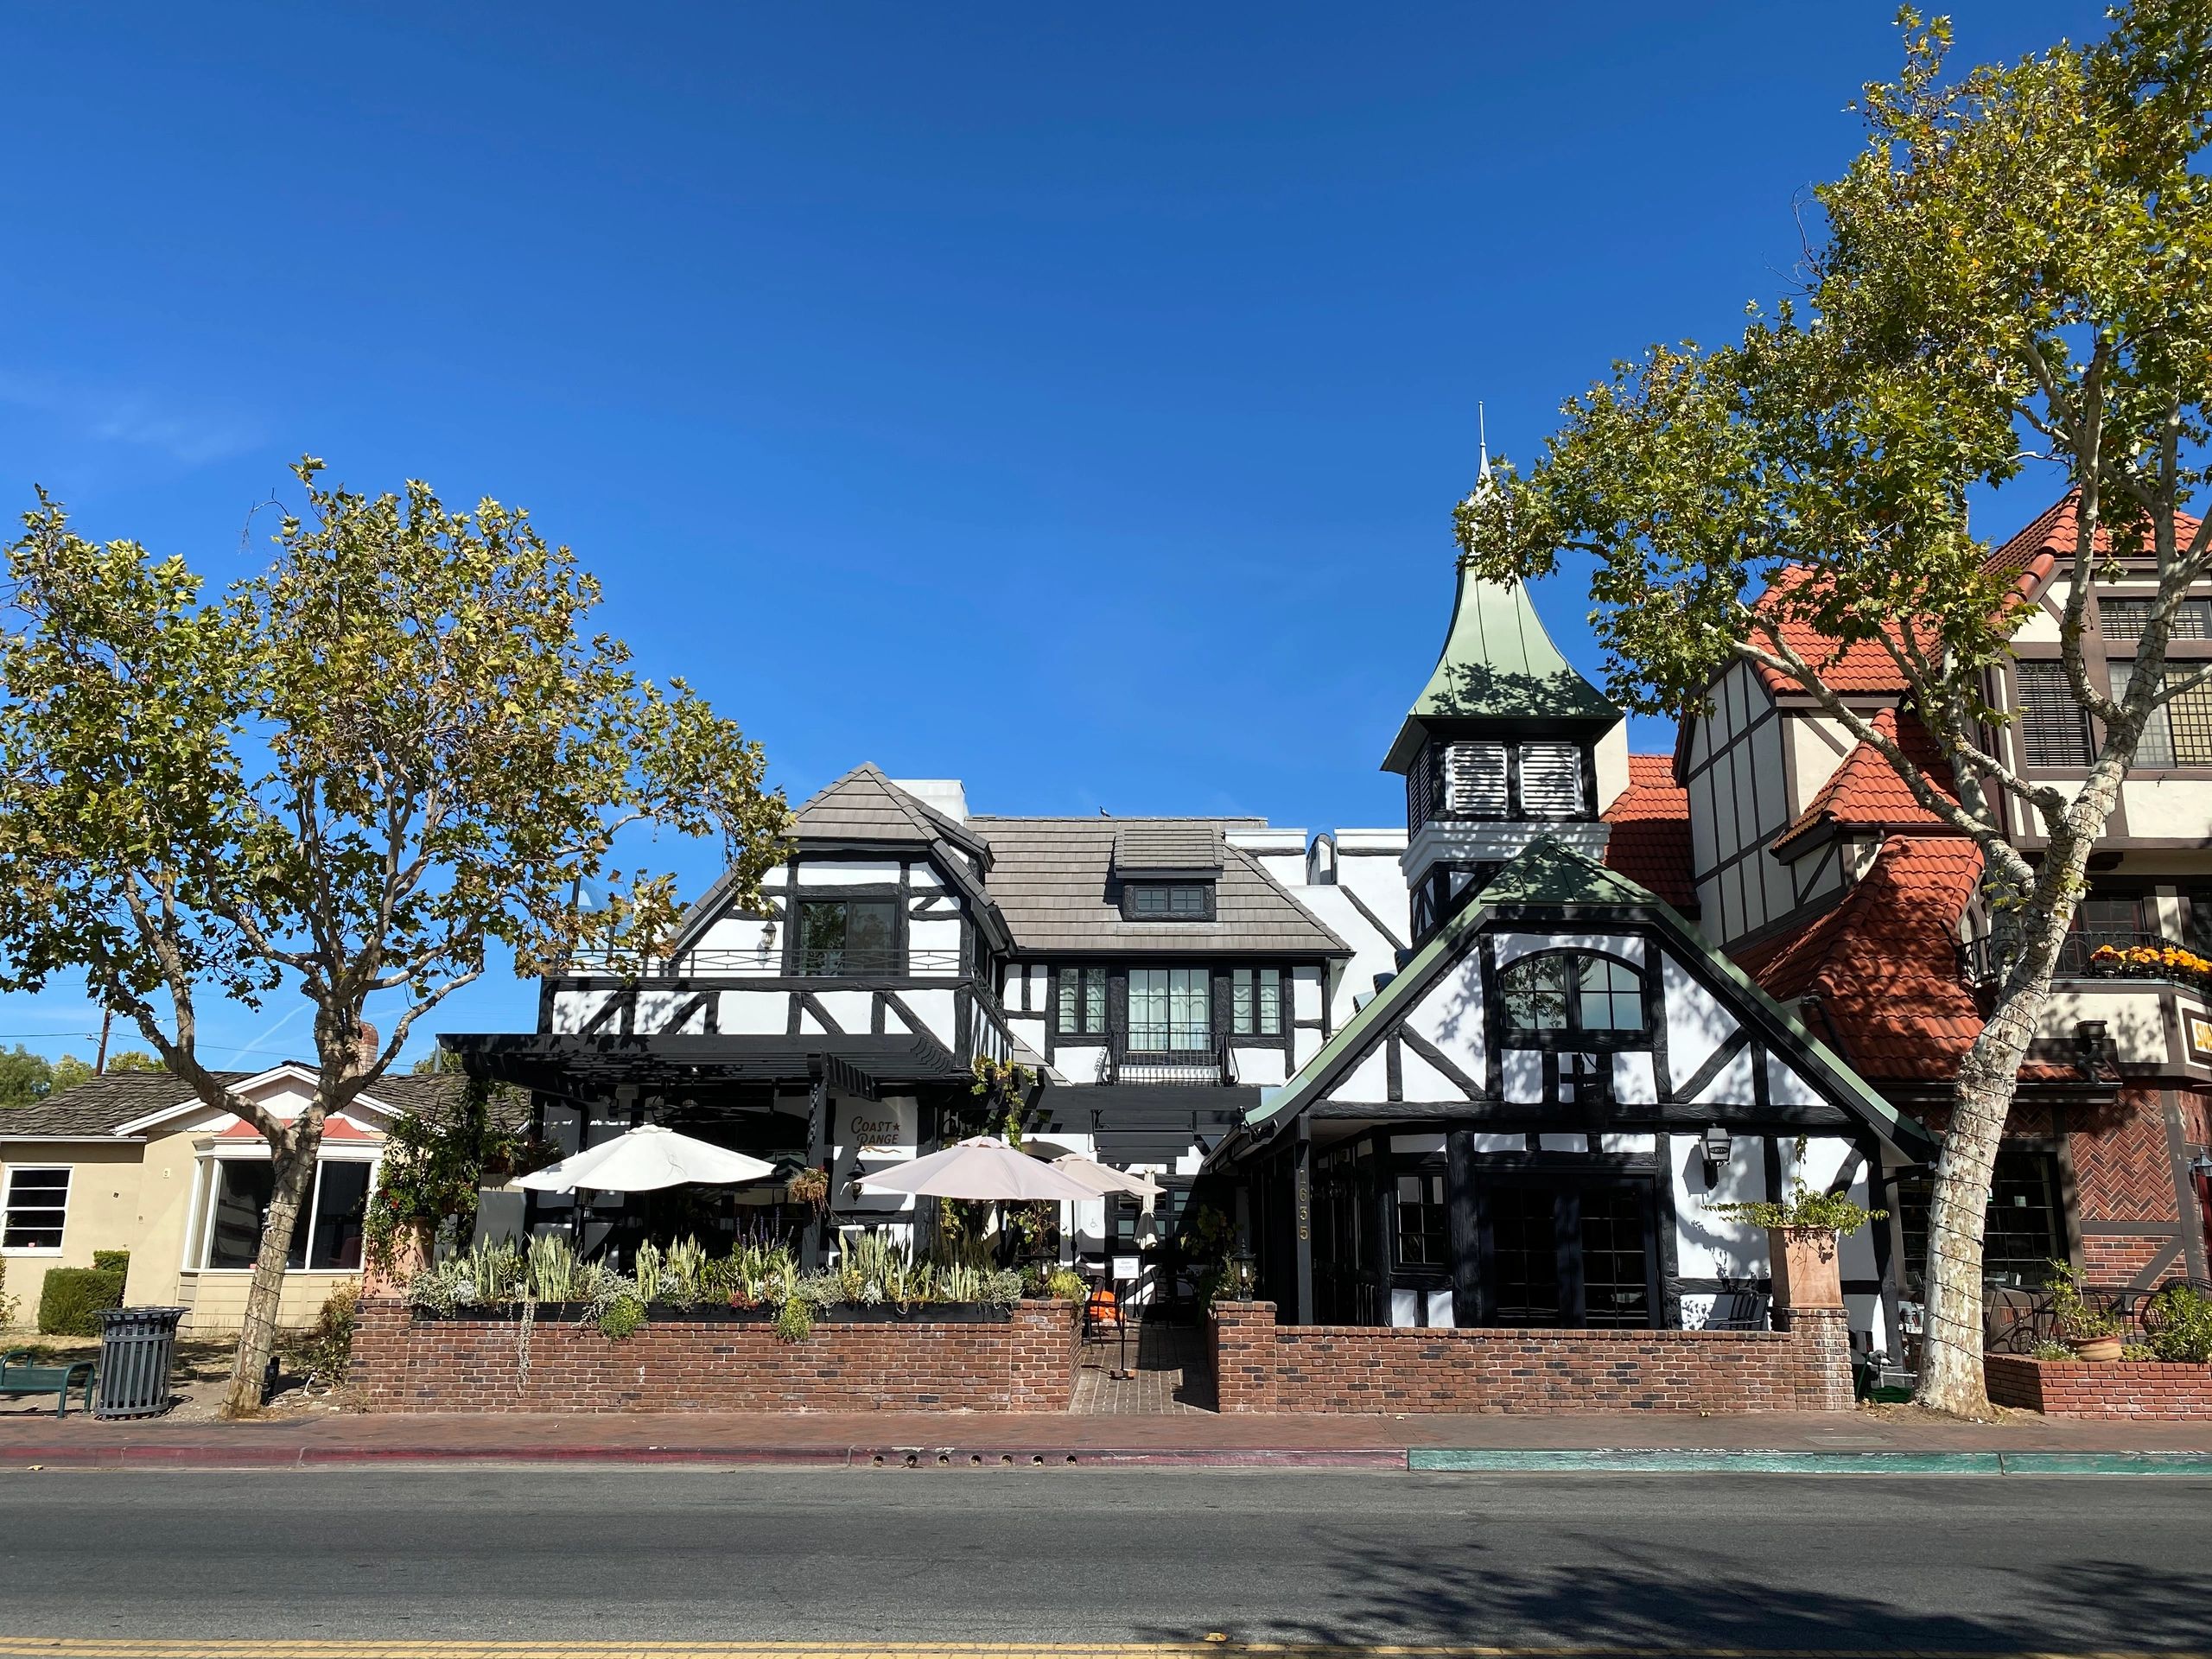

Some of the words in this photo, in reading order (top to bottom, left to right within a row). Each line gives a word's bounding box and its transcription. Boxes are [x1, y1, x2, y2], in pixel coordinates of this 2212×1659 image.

[851, 1116, 892, 1134] COAST
[854, 1133, 899, 1149] RANGE
[1299, 1169, 1308, 1240] 1635
